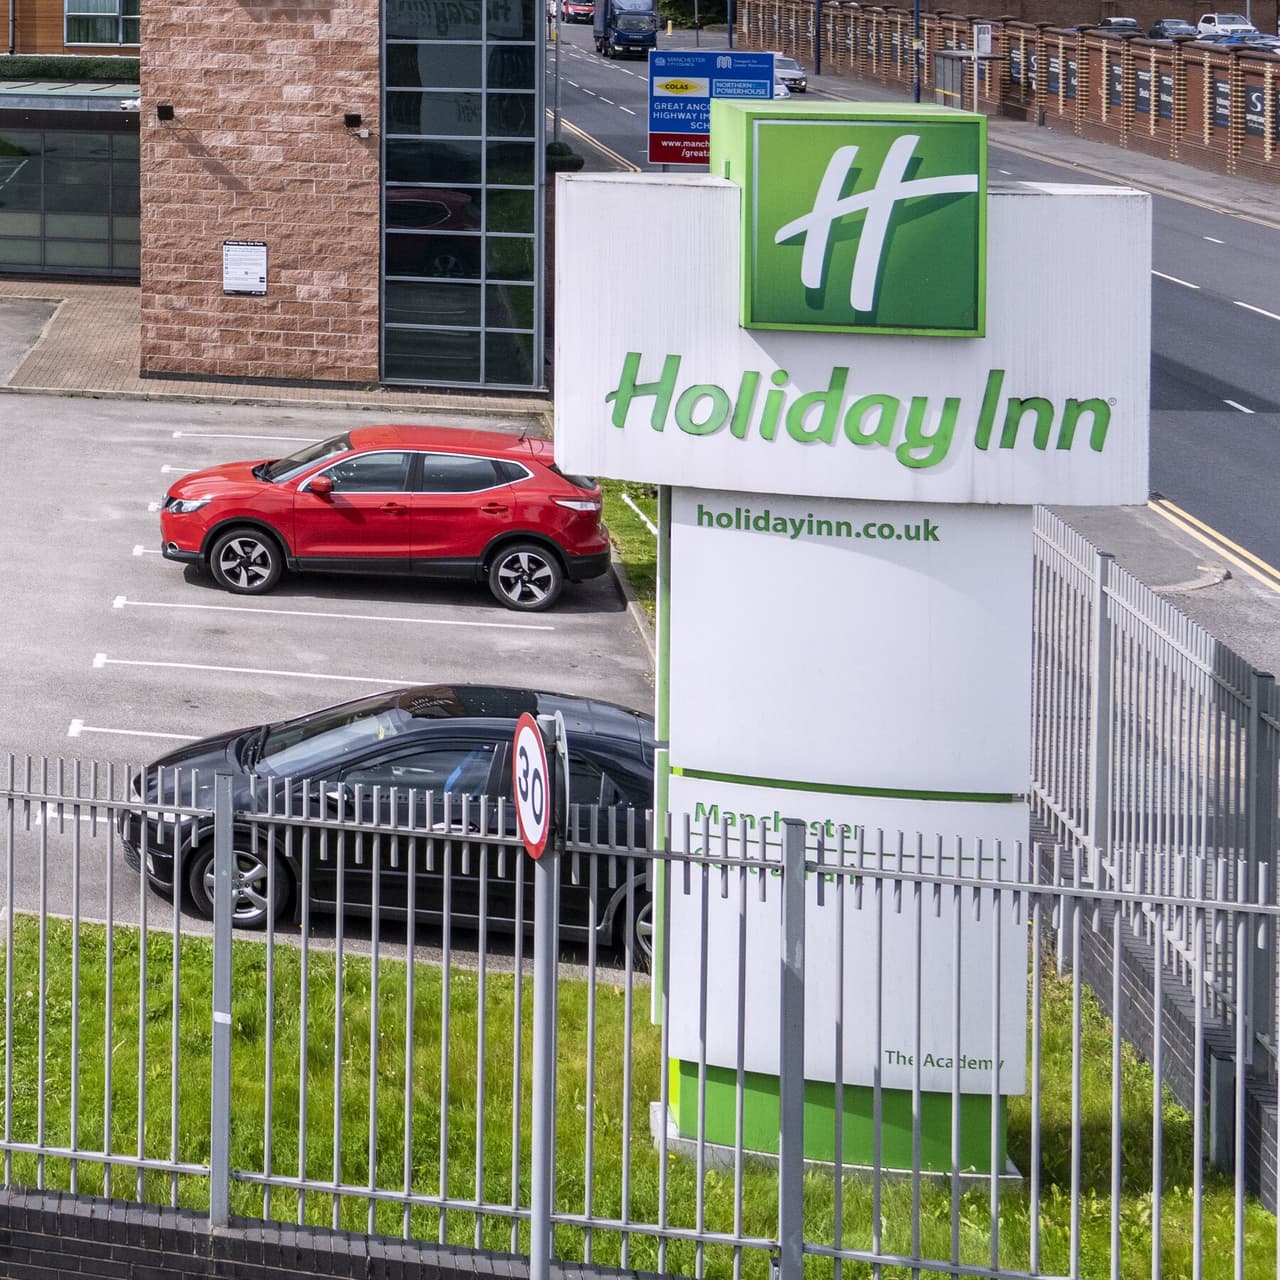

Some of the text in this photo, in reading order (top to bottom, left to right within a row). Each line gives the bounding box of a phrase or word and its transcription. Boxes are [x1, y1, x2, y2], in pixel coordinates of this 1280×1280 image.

[653, 111, 696, 120] HIGHWAY
[605, 351, 1111, 468] Holiday Inn
[697, 505, 940, 541] holidayinn.co.uk
[518, 745, 544, 826] 30
[885, 1050, 913, 1066] The
